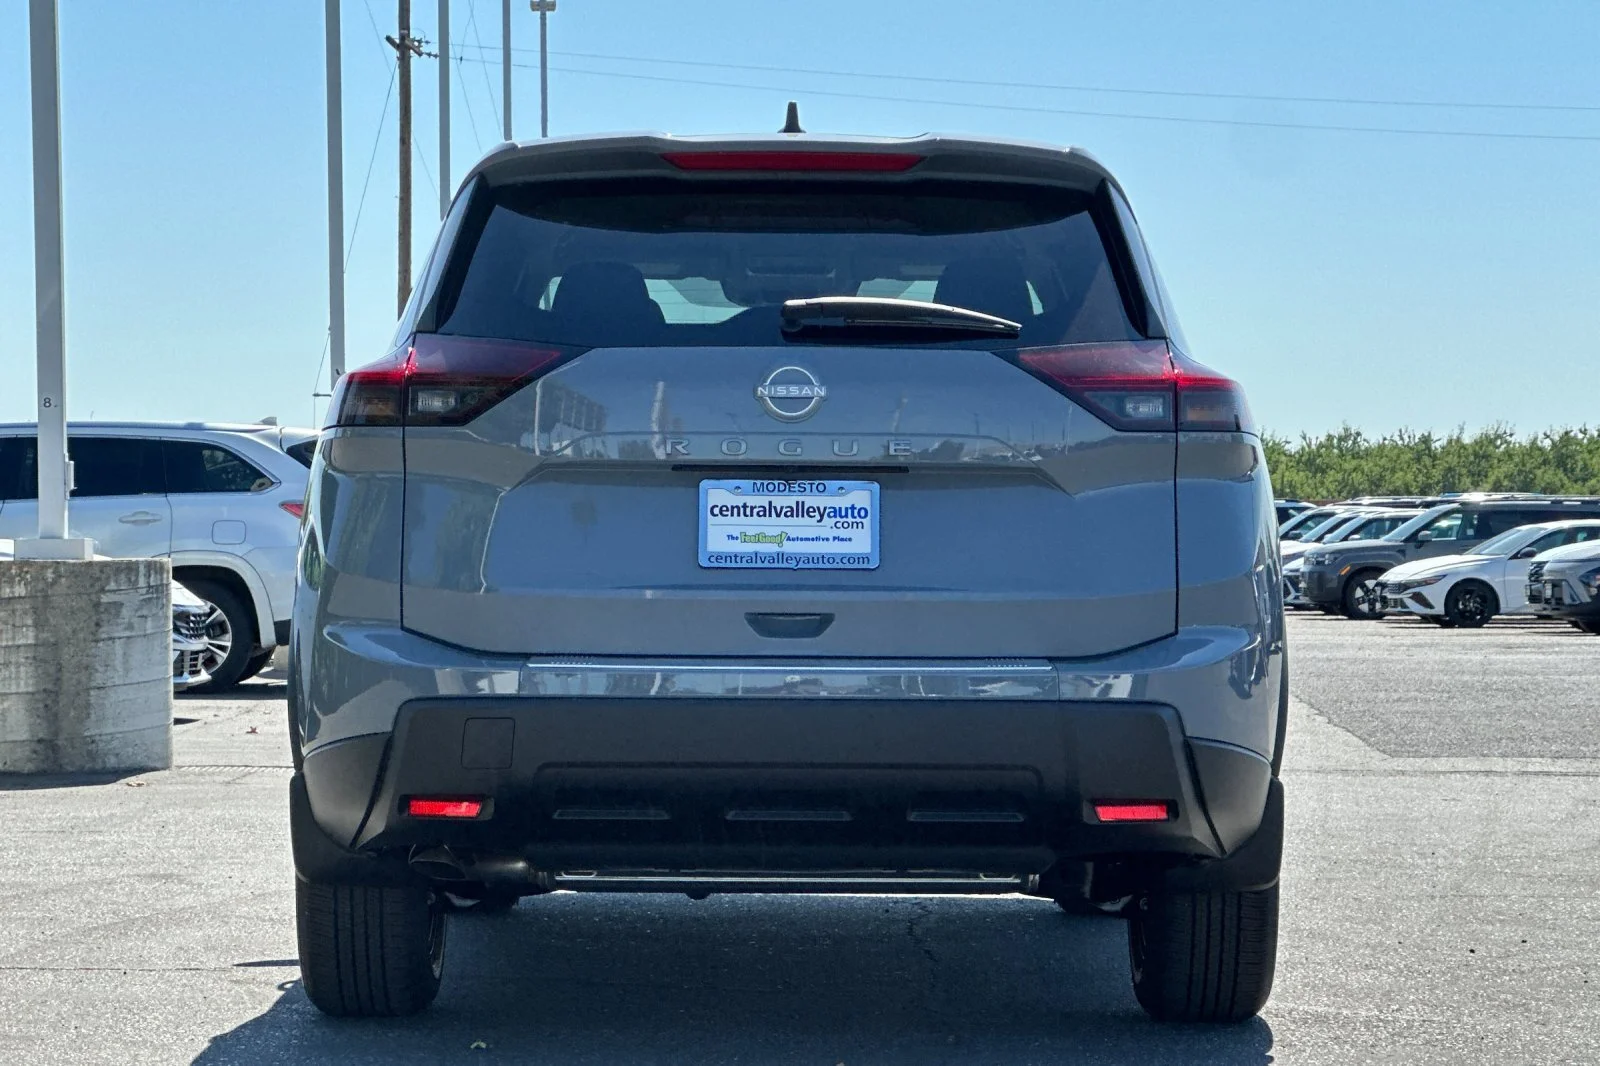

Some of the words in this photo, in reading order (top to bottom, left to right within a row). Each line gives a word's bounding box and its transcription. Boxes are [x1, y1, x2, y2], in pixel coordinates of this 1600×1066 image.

[757, 385, 827, 397] NISSAN
[43, 397, 51, 408] 8
[666, 437, 912, 456] ROGUE
[752, 482, 827, 494] MODESTO
[709, 501, 869, 523] centralvalleyauto
[829, 520, 865, 530] .com
[707, 552, 871, 567] centralvalleyauto.com
